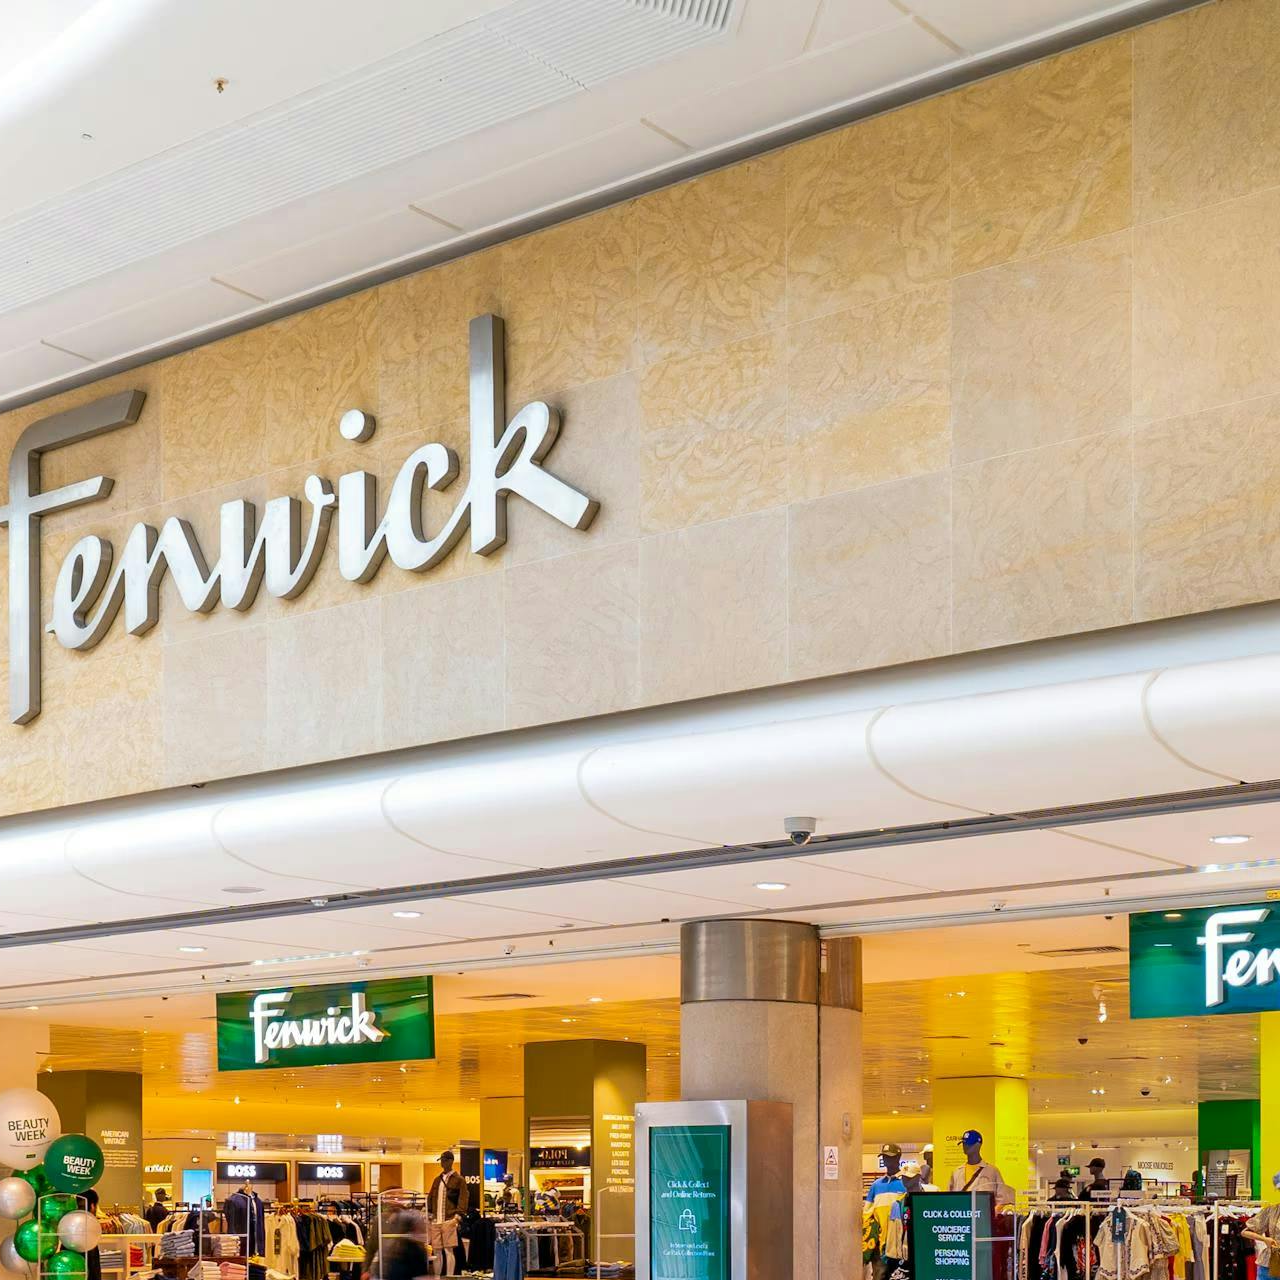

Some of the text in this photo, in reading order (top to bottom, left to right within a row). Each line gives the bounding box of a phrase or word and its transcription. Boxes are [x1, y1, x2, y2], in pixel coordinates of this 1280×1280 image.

[249, 992, 384, 1064] Fenwick
[8, 1117, 49, 1132] BEAUTY
[15, 1129, 46, 1141] WEEK
[101, 1130, 129, 1138] AMERICAN
[63, 1155, 96, 1167] BEAUTY
[1137, 1161, 1153, 1170] MOOSE
[66, 1165, 91, 1175] WEEK
[228, 1165, 256, 1177] BOSS
[316, 1166, 344, 1178] BOSS
[923, 1210, 943, 1218] CLICK
[943, 1210, 949, 1218] &
[932, 1226, 970, 1234] CONCIERGE
[935, 1249, 969, 1257] PERSONAL
